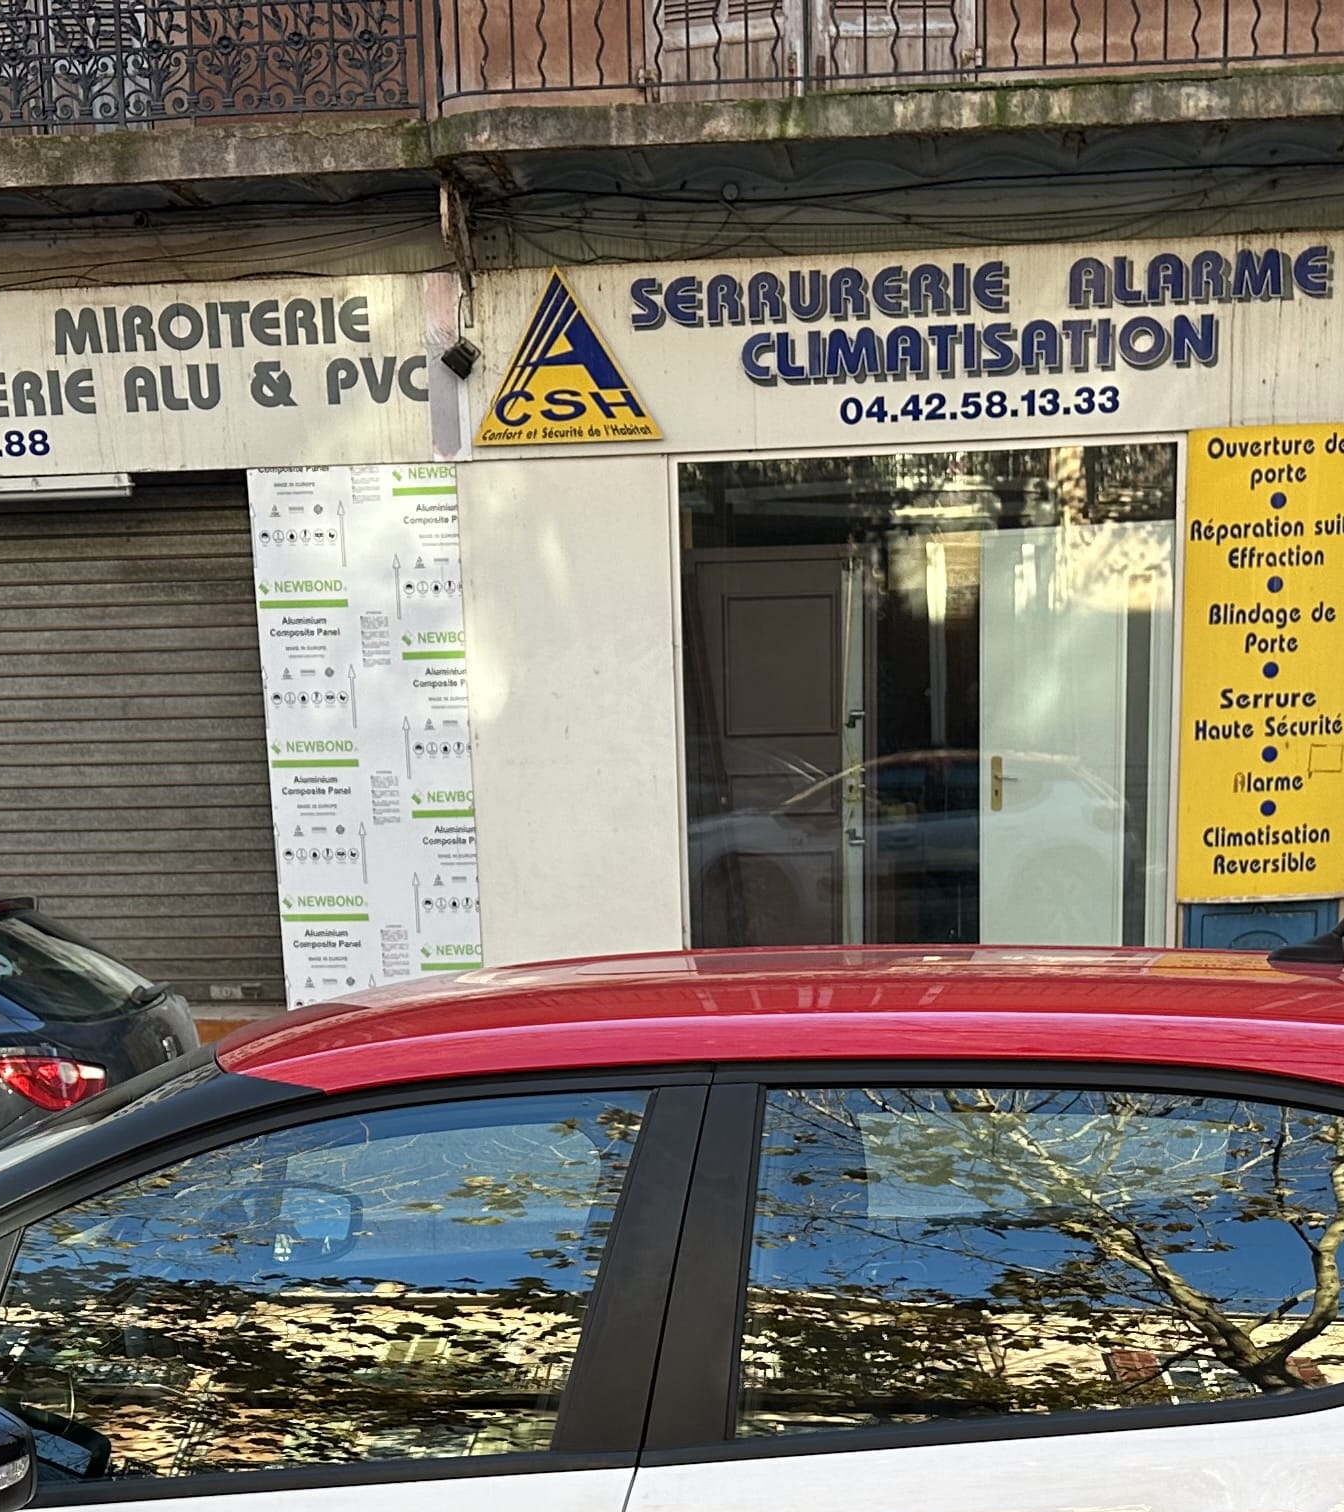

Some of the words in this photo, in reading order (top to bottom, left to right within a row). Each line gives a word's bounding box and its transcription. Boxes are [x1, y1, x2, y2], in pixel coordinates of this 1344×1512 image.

[630, 259, 1012, 332] SERRURERIE
[1068, 245, 1334, 311] ALARME
[55, 296, 371, 356] MIROITERIE
[741, 314, 1220, 386] CLIMATISATION
[125, 363, 220, 412] ALU
[251, 367, 297, 408] &
[327, 355, 429, 404] PVC
[495, 389, 646, 428] CSH
[840, 386, 1120, 425] 04.42.58.13.33
[482, 429, 522, 441] Confort
[542, 426, 583, 438] Sécurité
[588, 426, 601, 437] de
[1207, 436, 1315, 460] Ouverture
[1250, 464, 1307, 490] porte
[1190, 516, 1304, 545] Réparation
[1228, 547, 1324, 568] Effraction
[274, 580, 343, 593] NEWBOND
[1208, 604, 1301, 628] Blindage
[1311, 601, 1336, 622] de
[270, 628, 315, 638] Composite
[317, 627, 340, 636] Panel
[1244, 633, 1298, 654] Porte
[1220, 689, 1317, 709] Serrure
[1195, 720, 1254, 741] Haute
[1264, 713, 1343, 738] Sécurité
[286, 740, 353, 753] NEWBOND
[282, 786, 326, 796] Composite
[328, 786, 351, 795] Panel
[1233, 772, 1304, 793] Alarme
[1203, 824, 1330, 847] Climatisation
[1213, 853, 1316, 875] Reversible
[298, 895, 364, 907] NEWBOND
[293, 940, 337, 949] Composite
[339, 939, 362, 948] Panel
